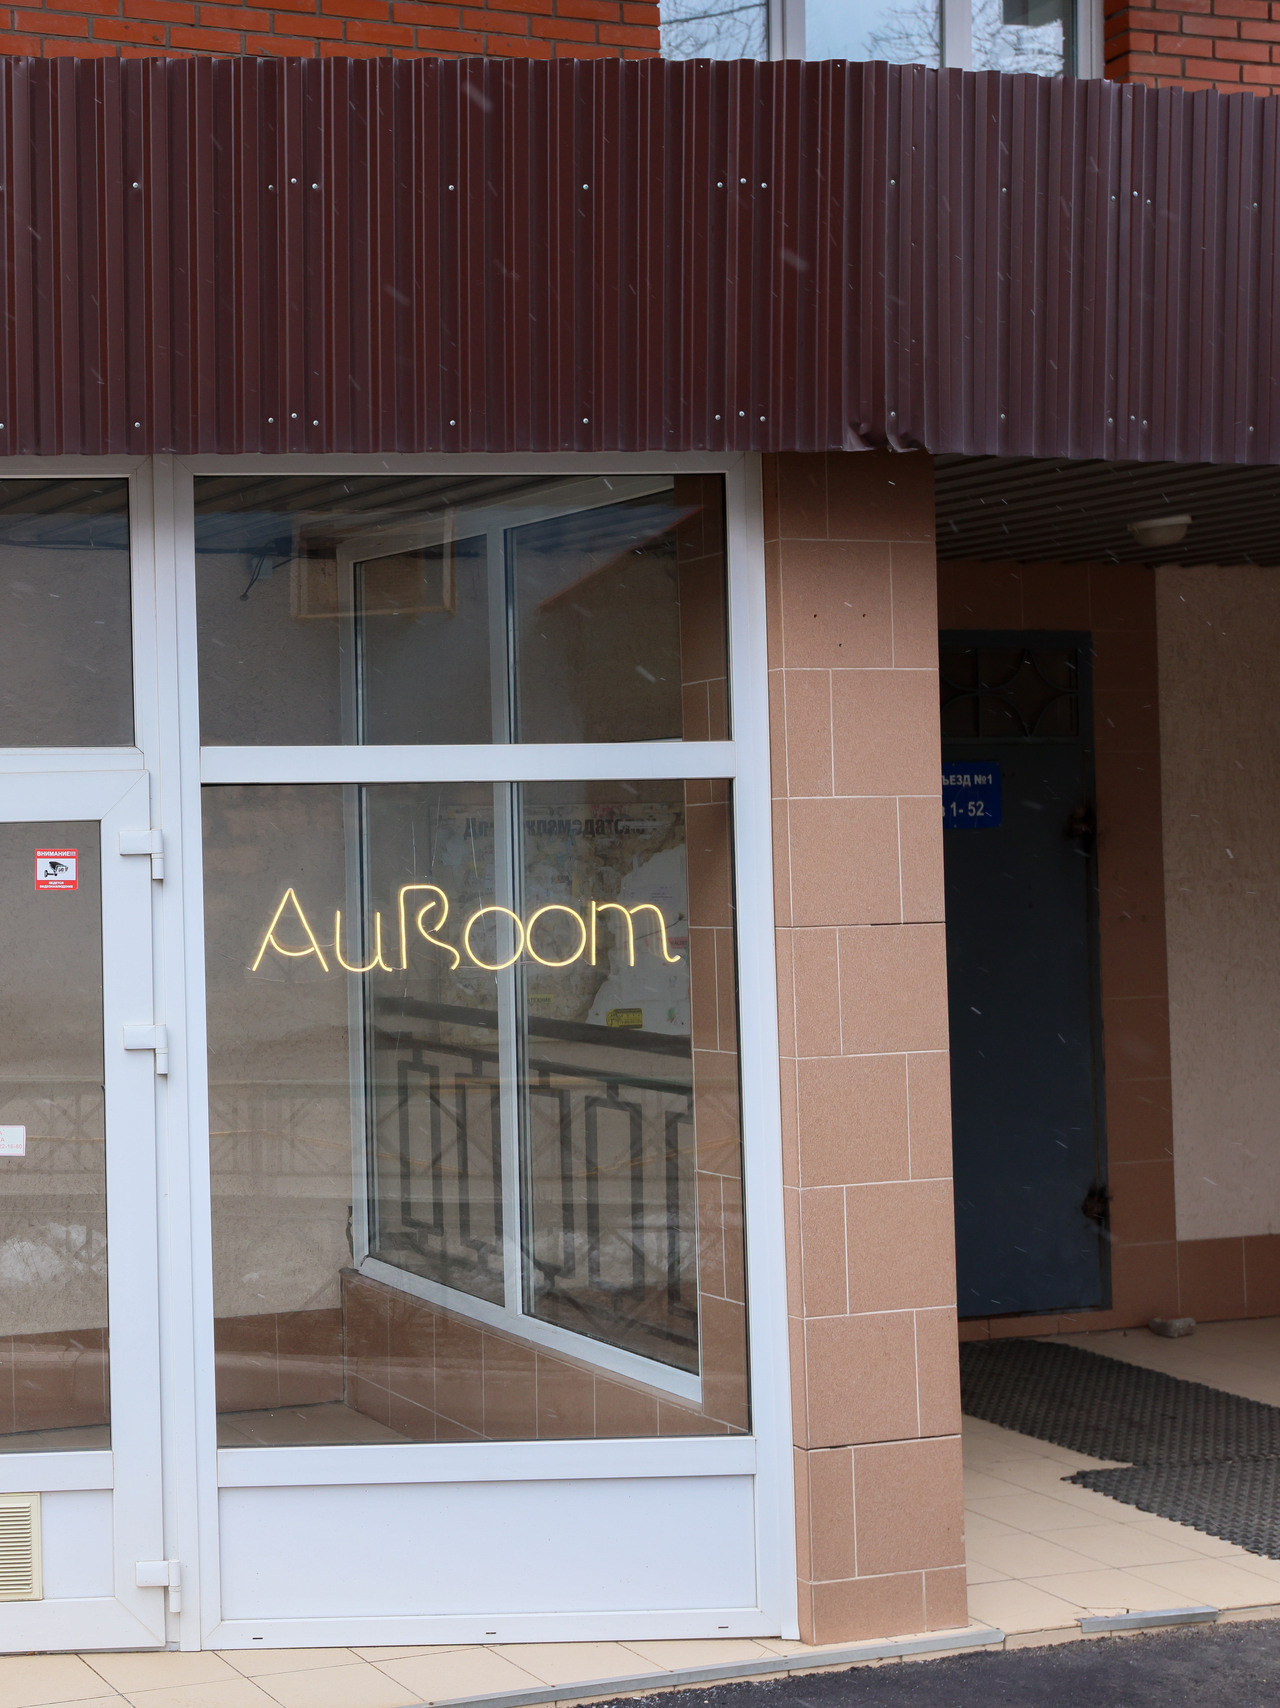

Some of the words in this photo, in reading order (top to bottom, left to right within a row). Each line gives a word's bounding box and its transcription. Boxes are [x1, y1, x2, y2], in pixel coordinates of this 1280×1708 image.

[974, 773, 993, 785] №1
[968, 800, 985, 816] 52
[251, 883, 682, 973] AuRoom
